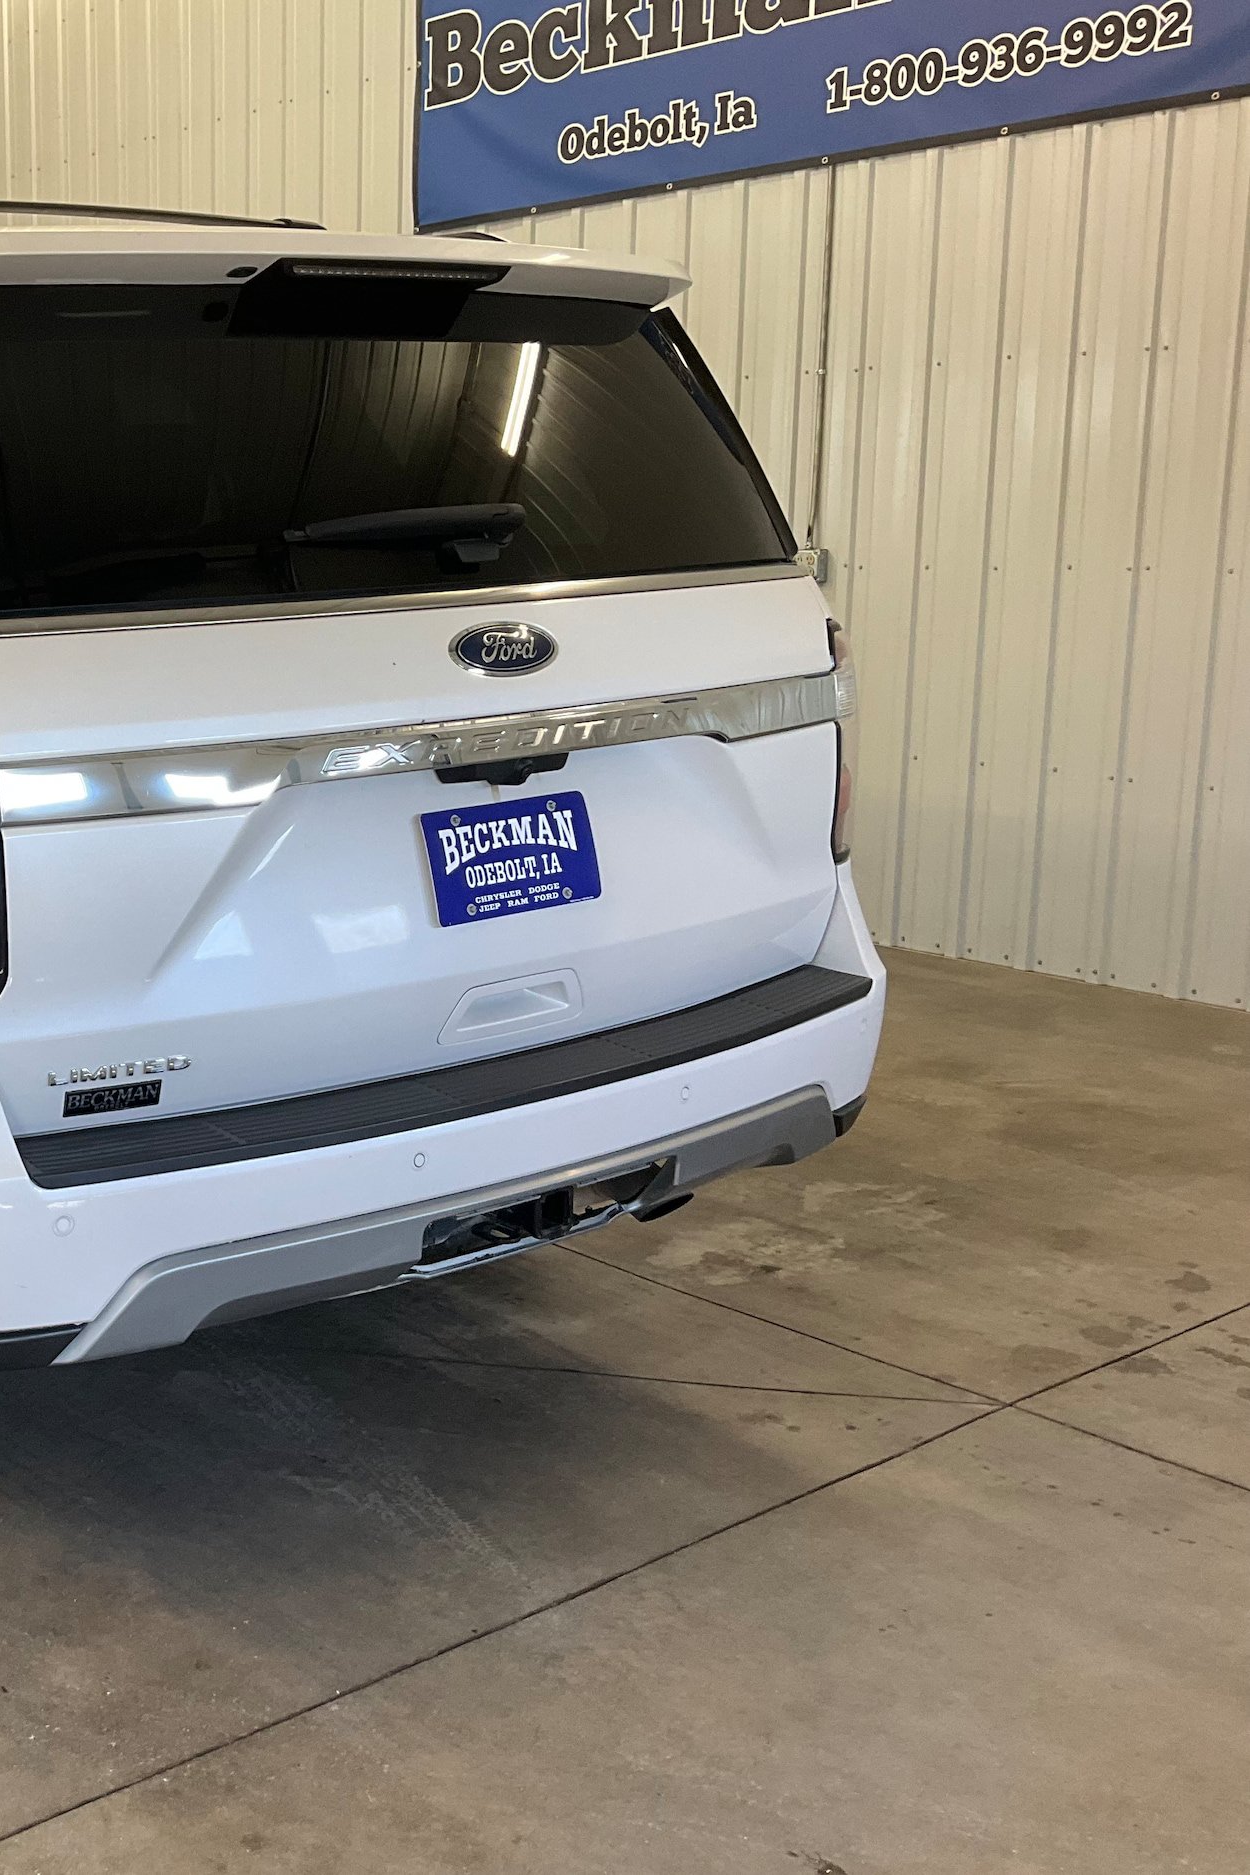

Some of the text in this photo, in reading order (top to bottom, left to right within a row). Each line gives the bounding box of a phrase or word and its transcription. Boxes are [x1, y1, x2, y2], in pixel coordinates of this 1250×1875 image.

[423, 0, 892, 111] Beckm
[826, 0, 1193, 114] 1-800-936-9992
[557, 90, 757, 165] Odebolt, Ia
[481, 624, 538, 663] Ford
[438, 809, 578, 876] BECKMAN
[465, 852, 562, 889] ODEBOLT, IA
[475, 882, 560, 904] CHRYSLER DODGE
[479, 902, 501, 913] JEEP
[507, 897, 529, 908] RAM
[534, 892, 559, 903] FORD
[47, 1054, 193, 1087] LIMITED
[67, 1083, 160, 1111] BECKMAN
